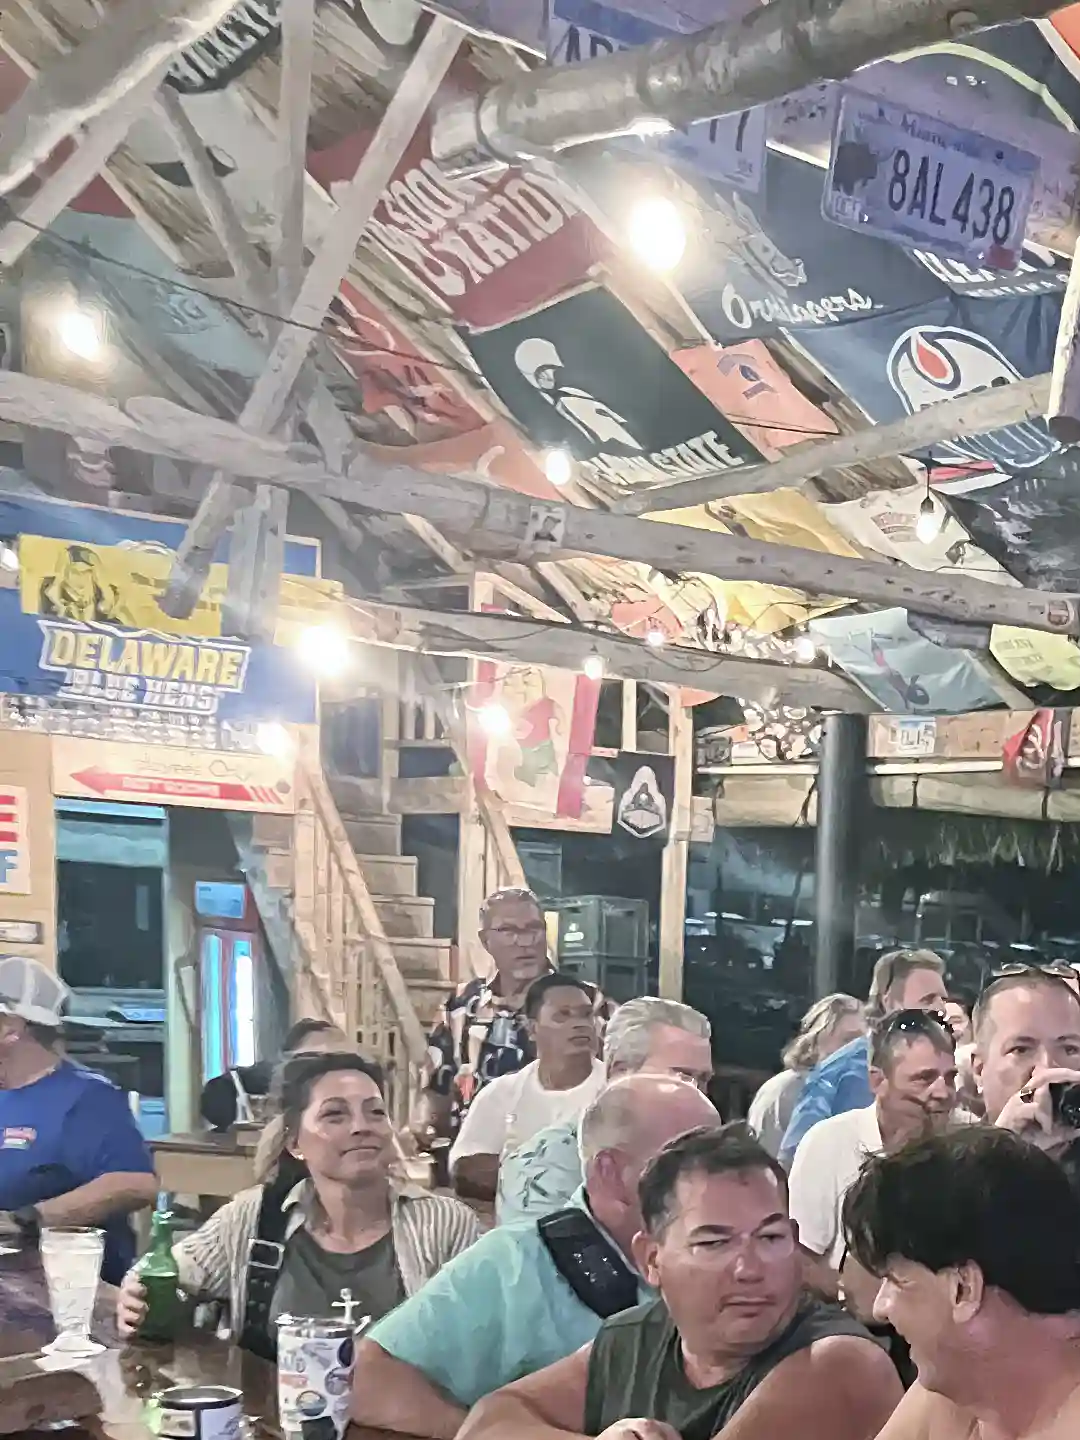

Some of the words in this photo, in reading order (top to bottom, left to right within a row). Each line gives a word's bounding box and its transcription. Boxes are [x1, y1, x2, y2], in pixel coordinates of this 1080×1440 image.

[50, 628, 244, 688] DELAWARE
[72, 669, 138, 702] BLUE
[142, 677, 216, 711] HENS
